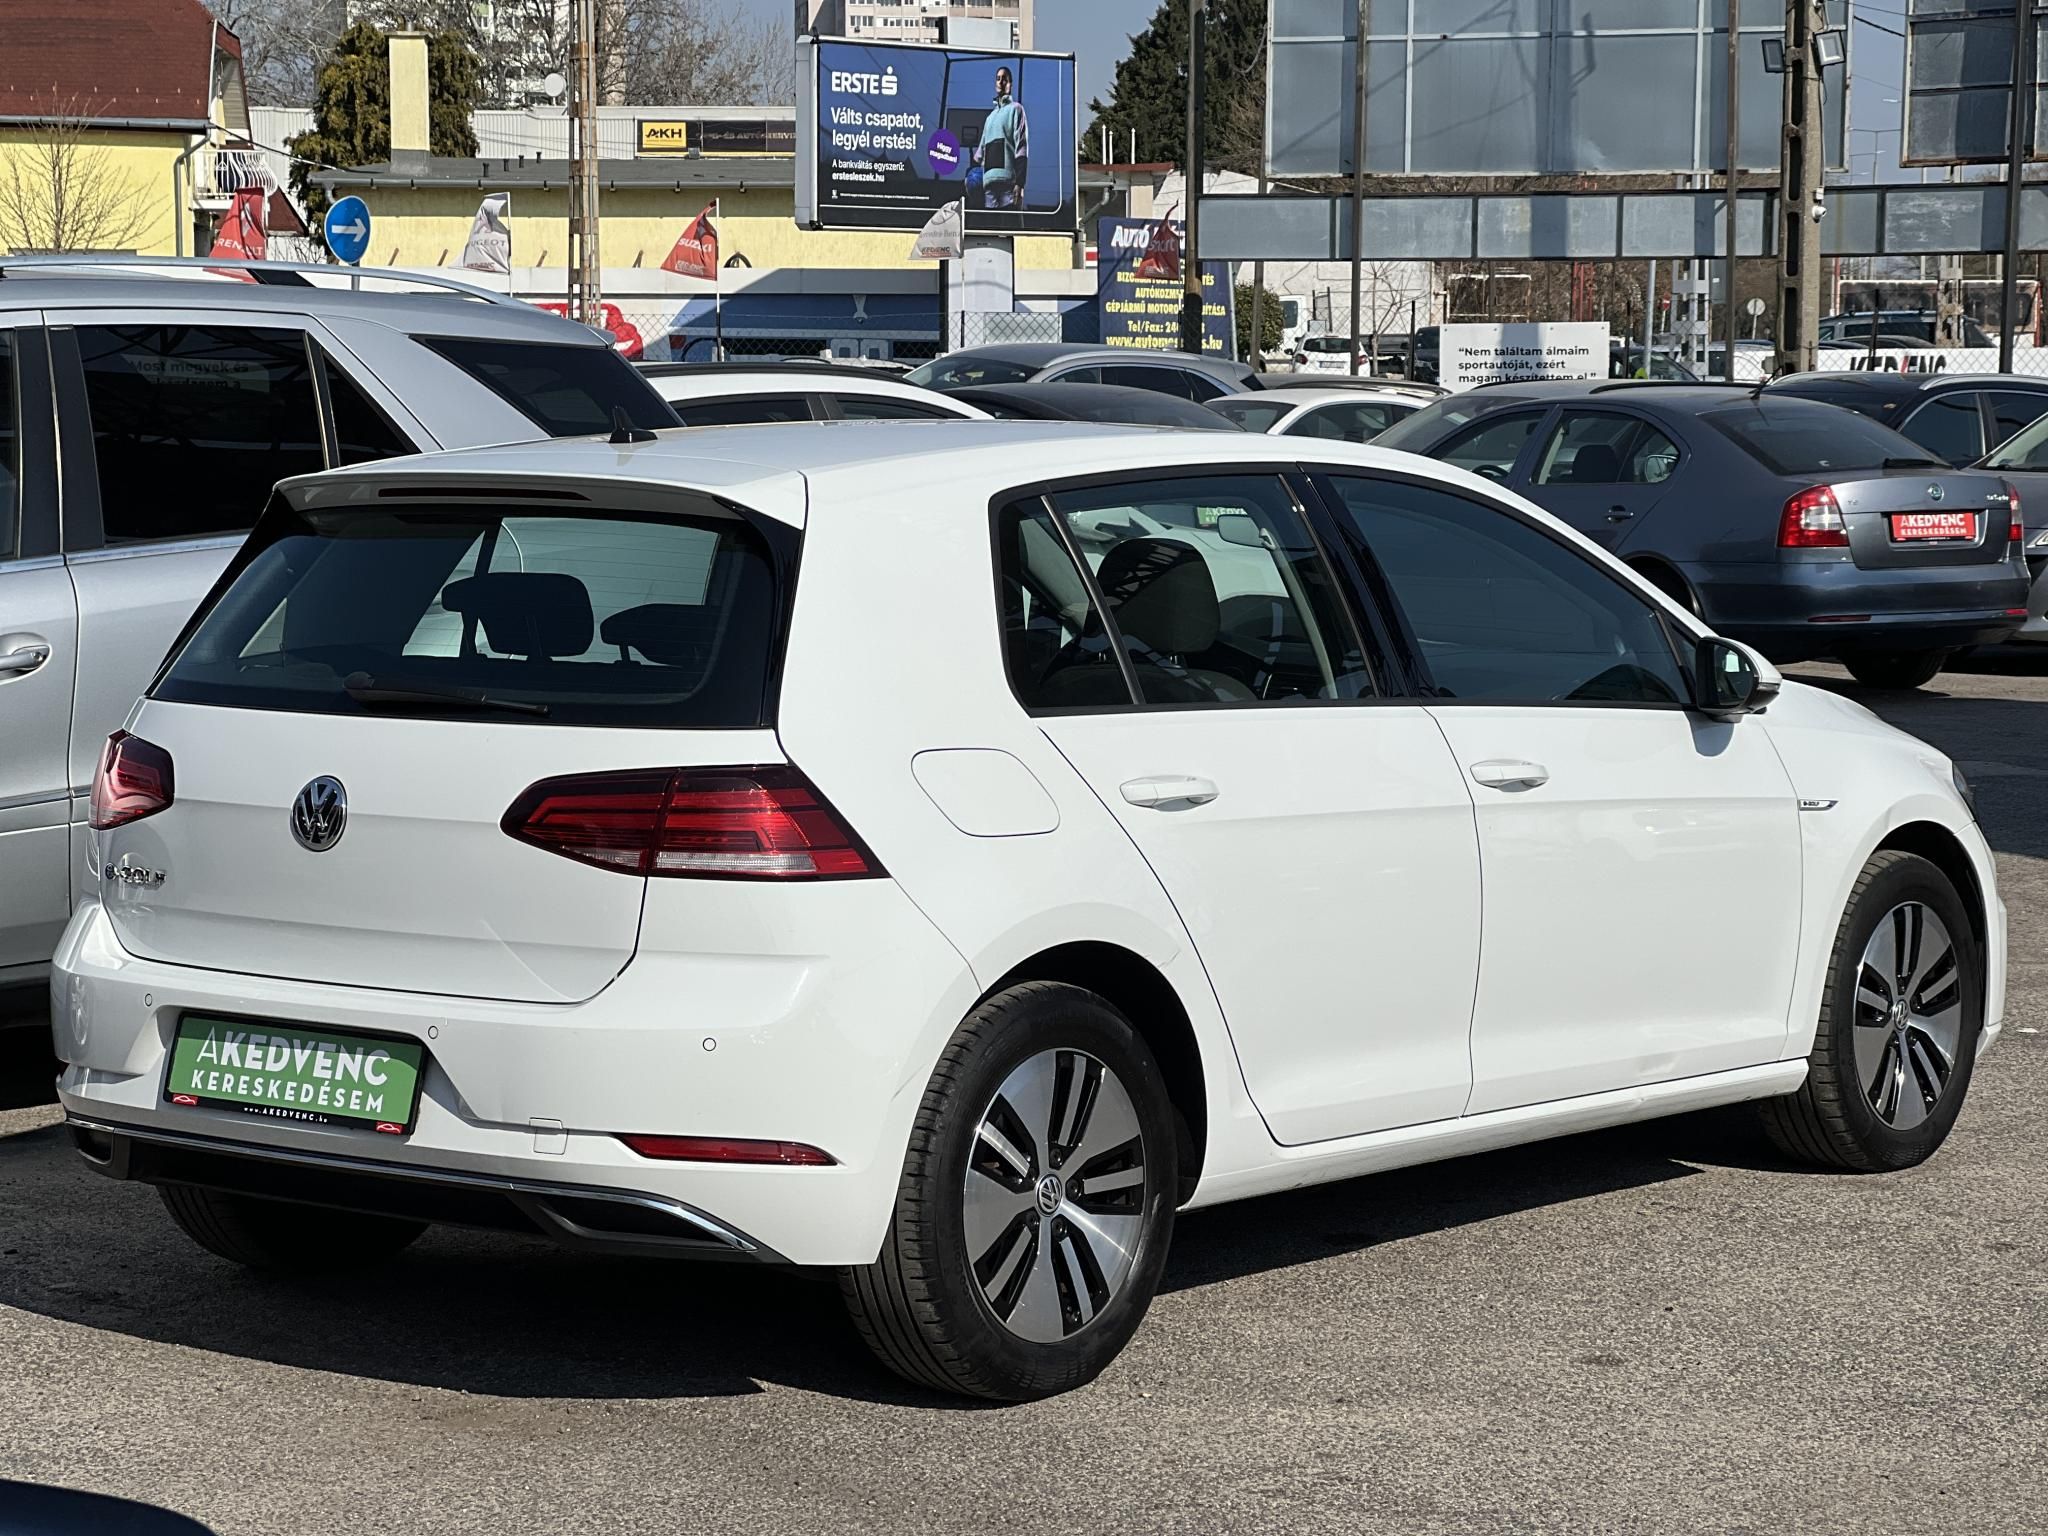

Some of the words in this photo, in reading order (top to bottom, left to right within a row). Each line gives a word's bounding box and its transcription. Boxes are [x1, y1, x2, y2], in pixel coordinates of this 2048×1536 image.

[831, 70, 880, 95] ERSTE
[830, 106, 863, 125] Válts
[865, 112, 924, 132] csapatot,
[645, 128, 683, 138] AKH
[832, 129, 870, 151] legyél
[872, 132, 916, 150] erstés!
[832, 158, 838, 168] A
[838, 159, 873, 170] bankváltás
[873, 161, 905, 172] egyszerű:
[216, 238, 264, 256] RENLT
[1105, 299, 1146, 313] GÉPJÁRMŰ
[1127, 320, 1164, 334] Tel/Fax:
[1458, 346, 1491, 356] “Nem
[1494, 346, 1543, 356] találtam
[1545, 345, 1590, 356] álmaim
[1458, 360, 1533, 371] sportautóját,
[1535, 359, 1566, 369] ezért
[1458, 375, 1502, 385] magam
[1900, 513, 1965, 527] AKEDVENC
[195, 1025, 392, 1087] AKEDVENC
[190, 1068, 385, 1114] KERESKEDÉSEM
[243, 1107, 328, 1123] www.AKEDVENC.hu
